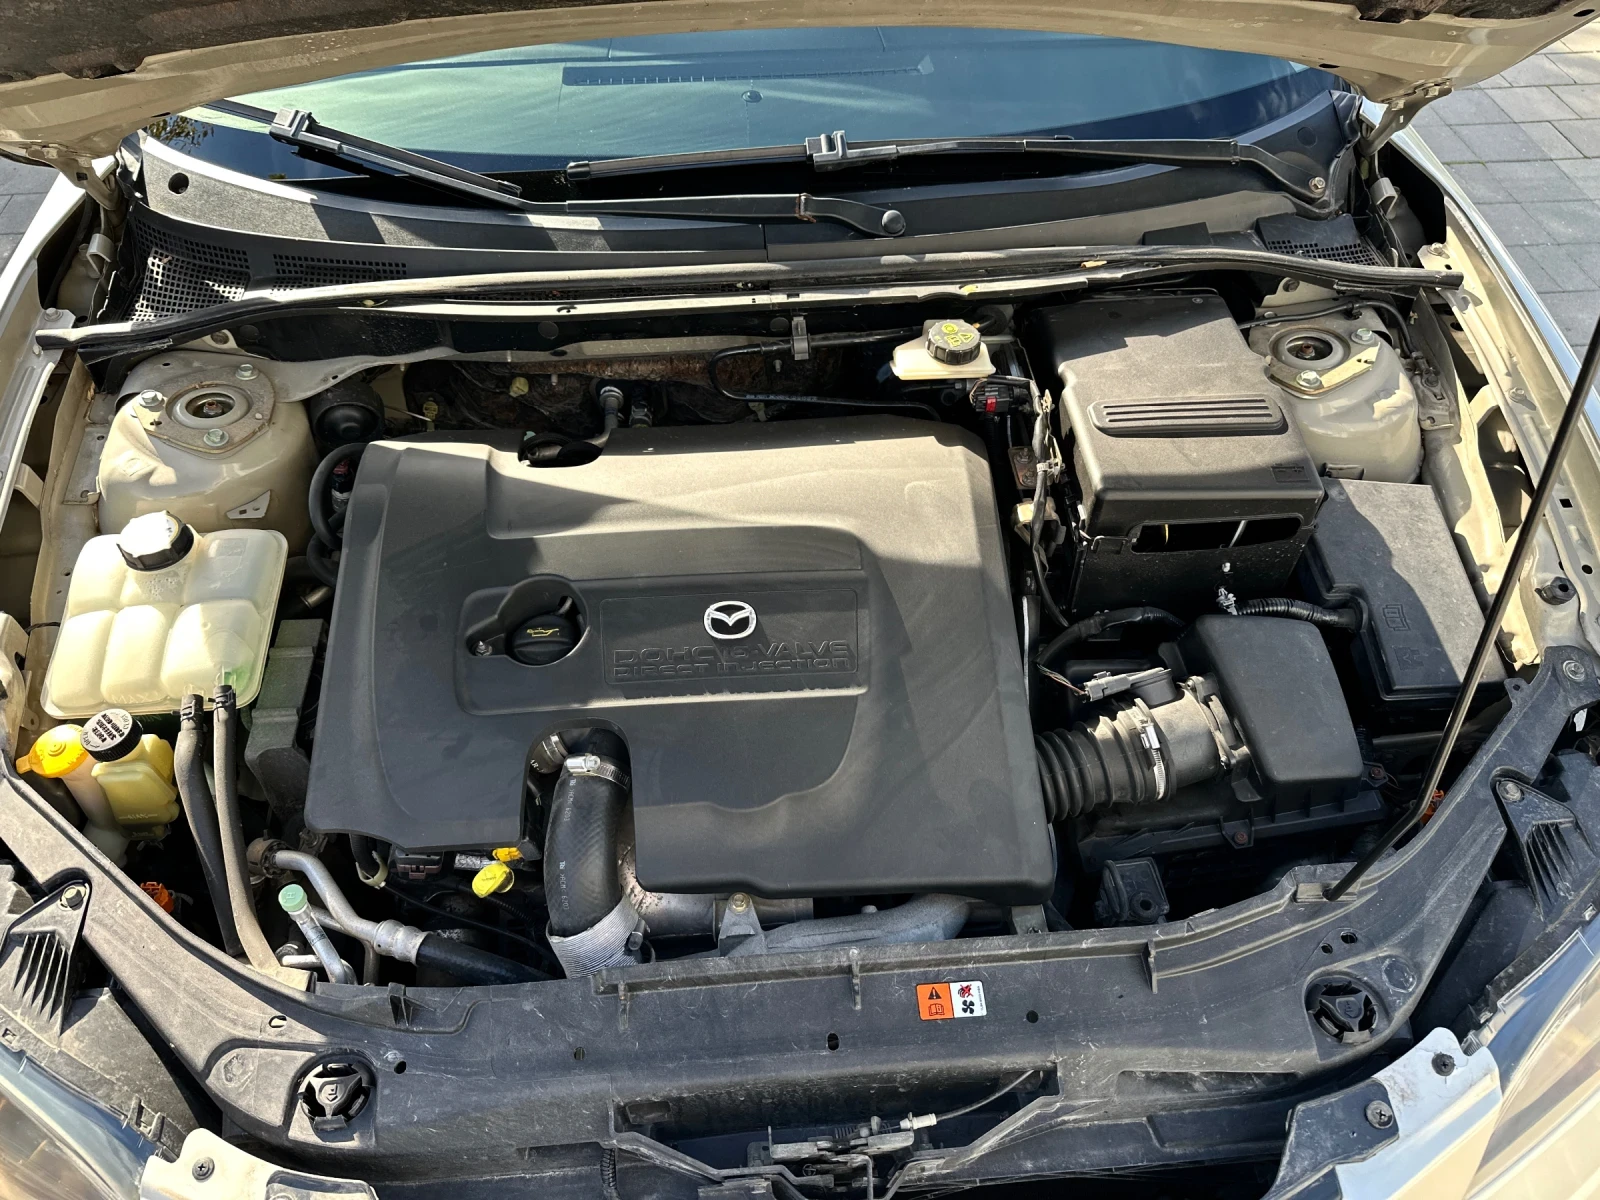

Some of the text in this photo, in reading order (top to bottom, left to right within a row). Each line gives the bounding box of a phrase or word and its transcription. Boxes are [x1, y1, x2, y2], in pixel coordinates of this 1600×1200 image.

[614, 645, 715, 664] DOHC
[613, 663, 709, 677] DIRECT
[111, 692, 152, 705] MAX
